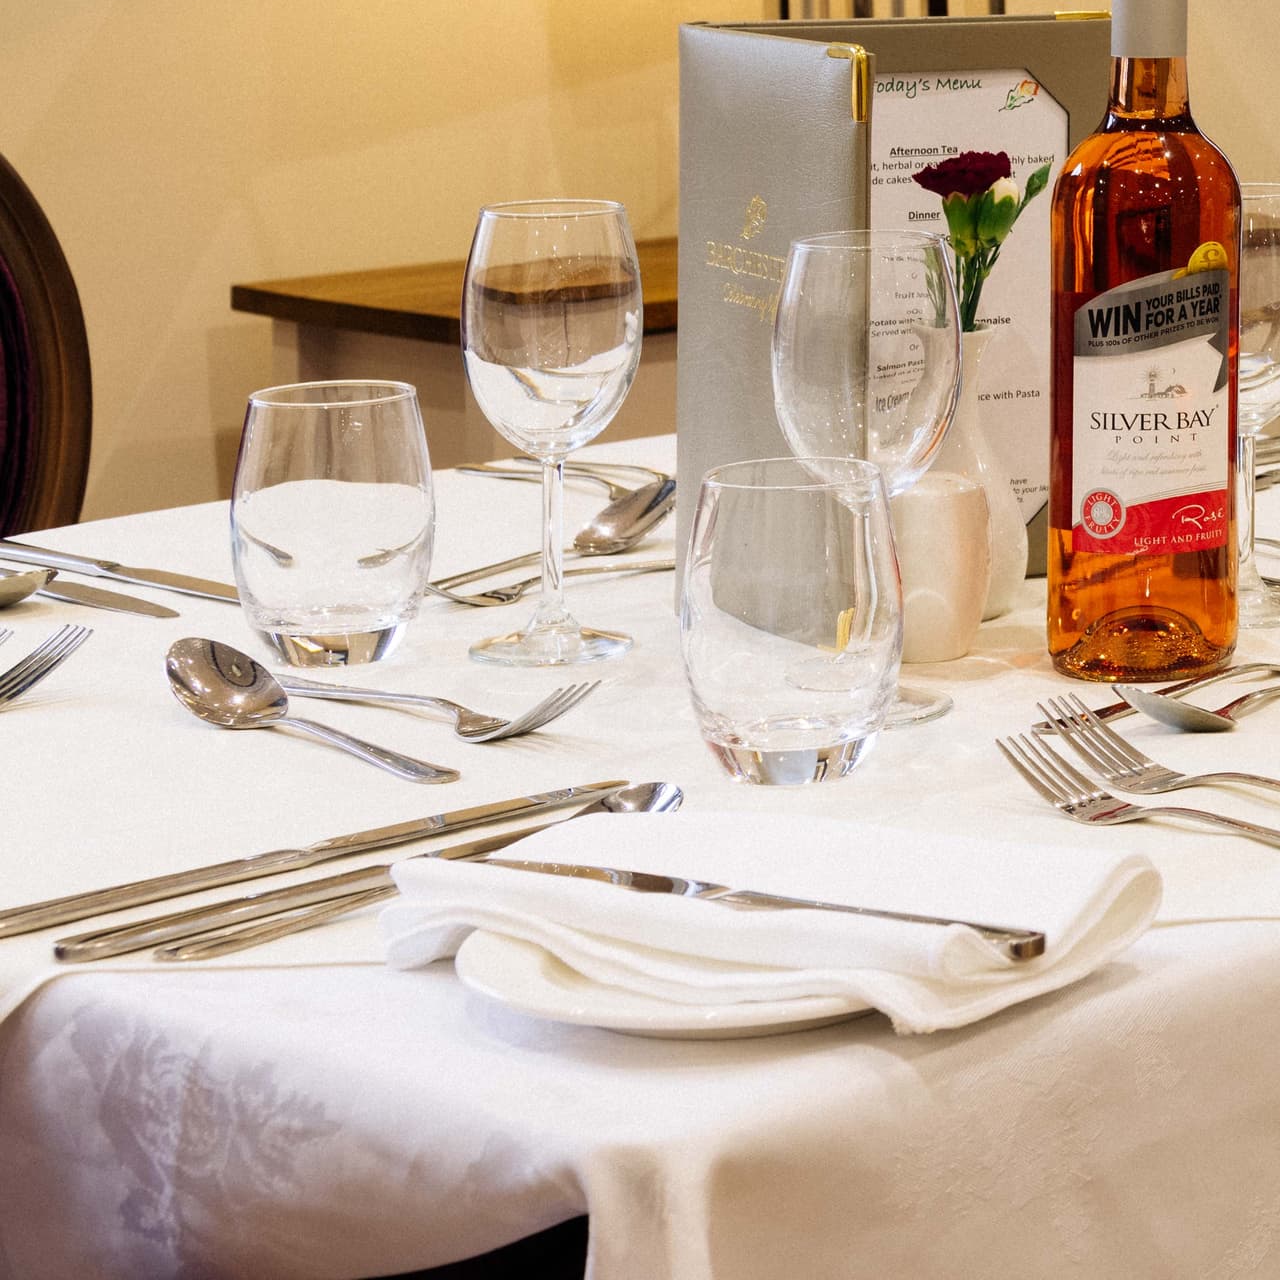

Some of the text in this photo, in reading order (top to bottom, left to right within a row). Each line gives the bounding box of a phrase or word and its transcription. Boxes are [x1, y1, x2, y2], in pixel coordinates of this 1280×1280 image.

[935, 77, 982, 91] Menu
[890, 145, 959, 157] Afternoon Tea
[882, 160, 912, 171] herbal
[914, 162, 924, 170] or
[1027, 154, 1055, 165] baked
[886, 175, 913, 186] cakes
[908, 210, 941, 222] Dinner
[706, 241, 786, 282] BARCHESTE
[1145, 282, 1220, 311] YOUR BILLS PAID
[1088, 301, 1142, 338] WIN
[1145, 308, 1175, 331] FOR
[1178, 303, 1188, 321] A
[871, 328, 898, 338] Served
[1122, 337, 1133, 345] OF
[1134, 330, 1159, 342] OTHER
[1160, 325, 1185, 336] PRIZES
[1186, 320, 1195, 329] TO
[909, 343, 920, 352] Or
[876, 359, 925, 372] Salmon Past
[993, 390, 1014, 400] with
[1015, 389, 1041, 399] Pasta
[875, 395, 887, 412] Ice
[1090, 408, 1215, 431] SILVER BAY
[1115, 432, 1197, 444] POINT
[1009, 478, 1028, 486] have
[1021, 487, 1038, 495] your
[1087, 493, 1119, 507] LIGHT
[1171, 504, 1225, 530] Rosé
[1084, 515, 1120, 534] FRUITY
[1133, 528, 1222, 546] LIGHT AND FRUITY
